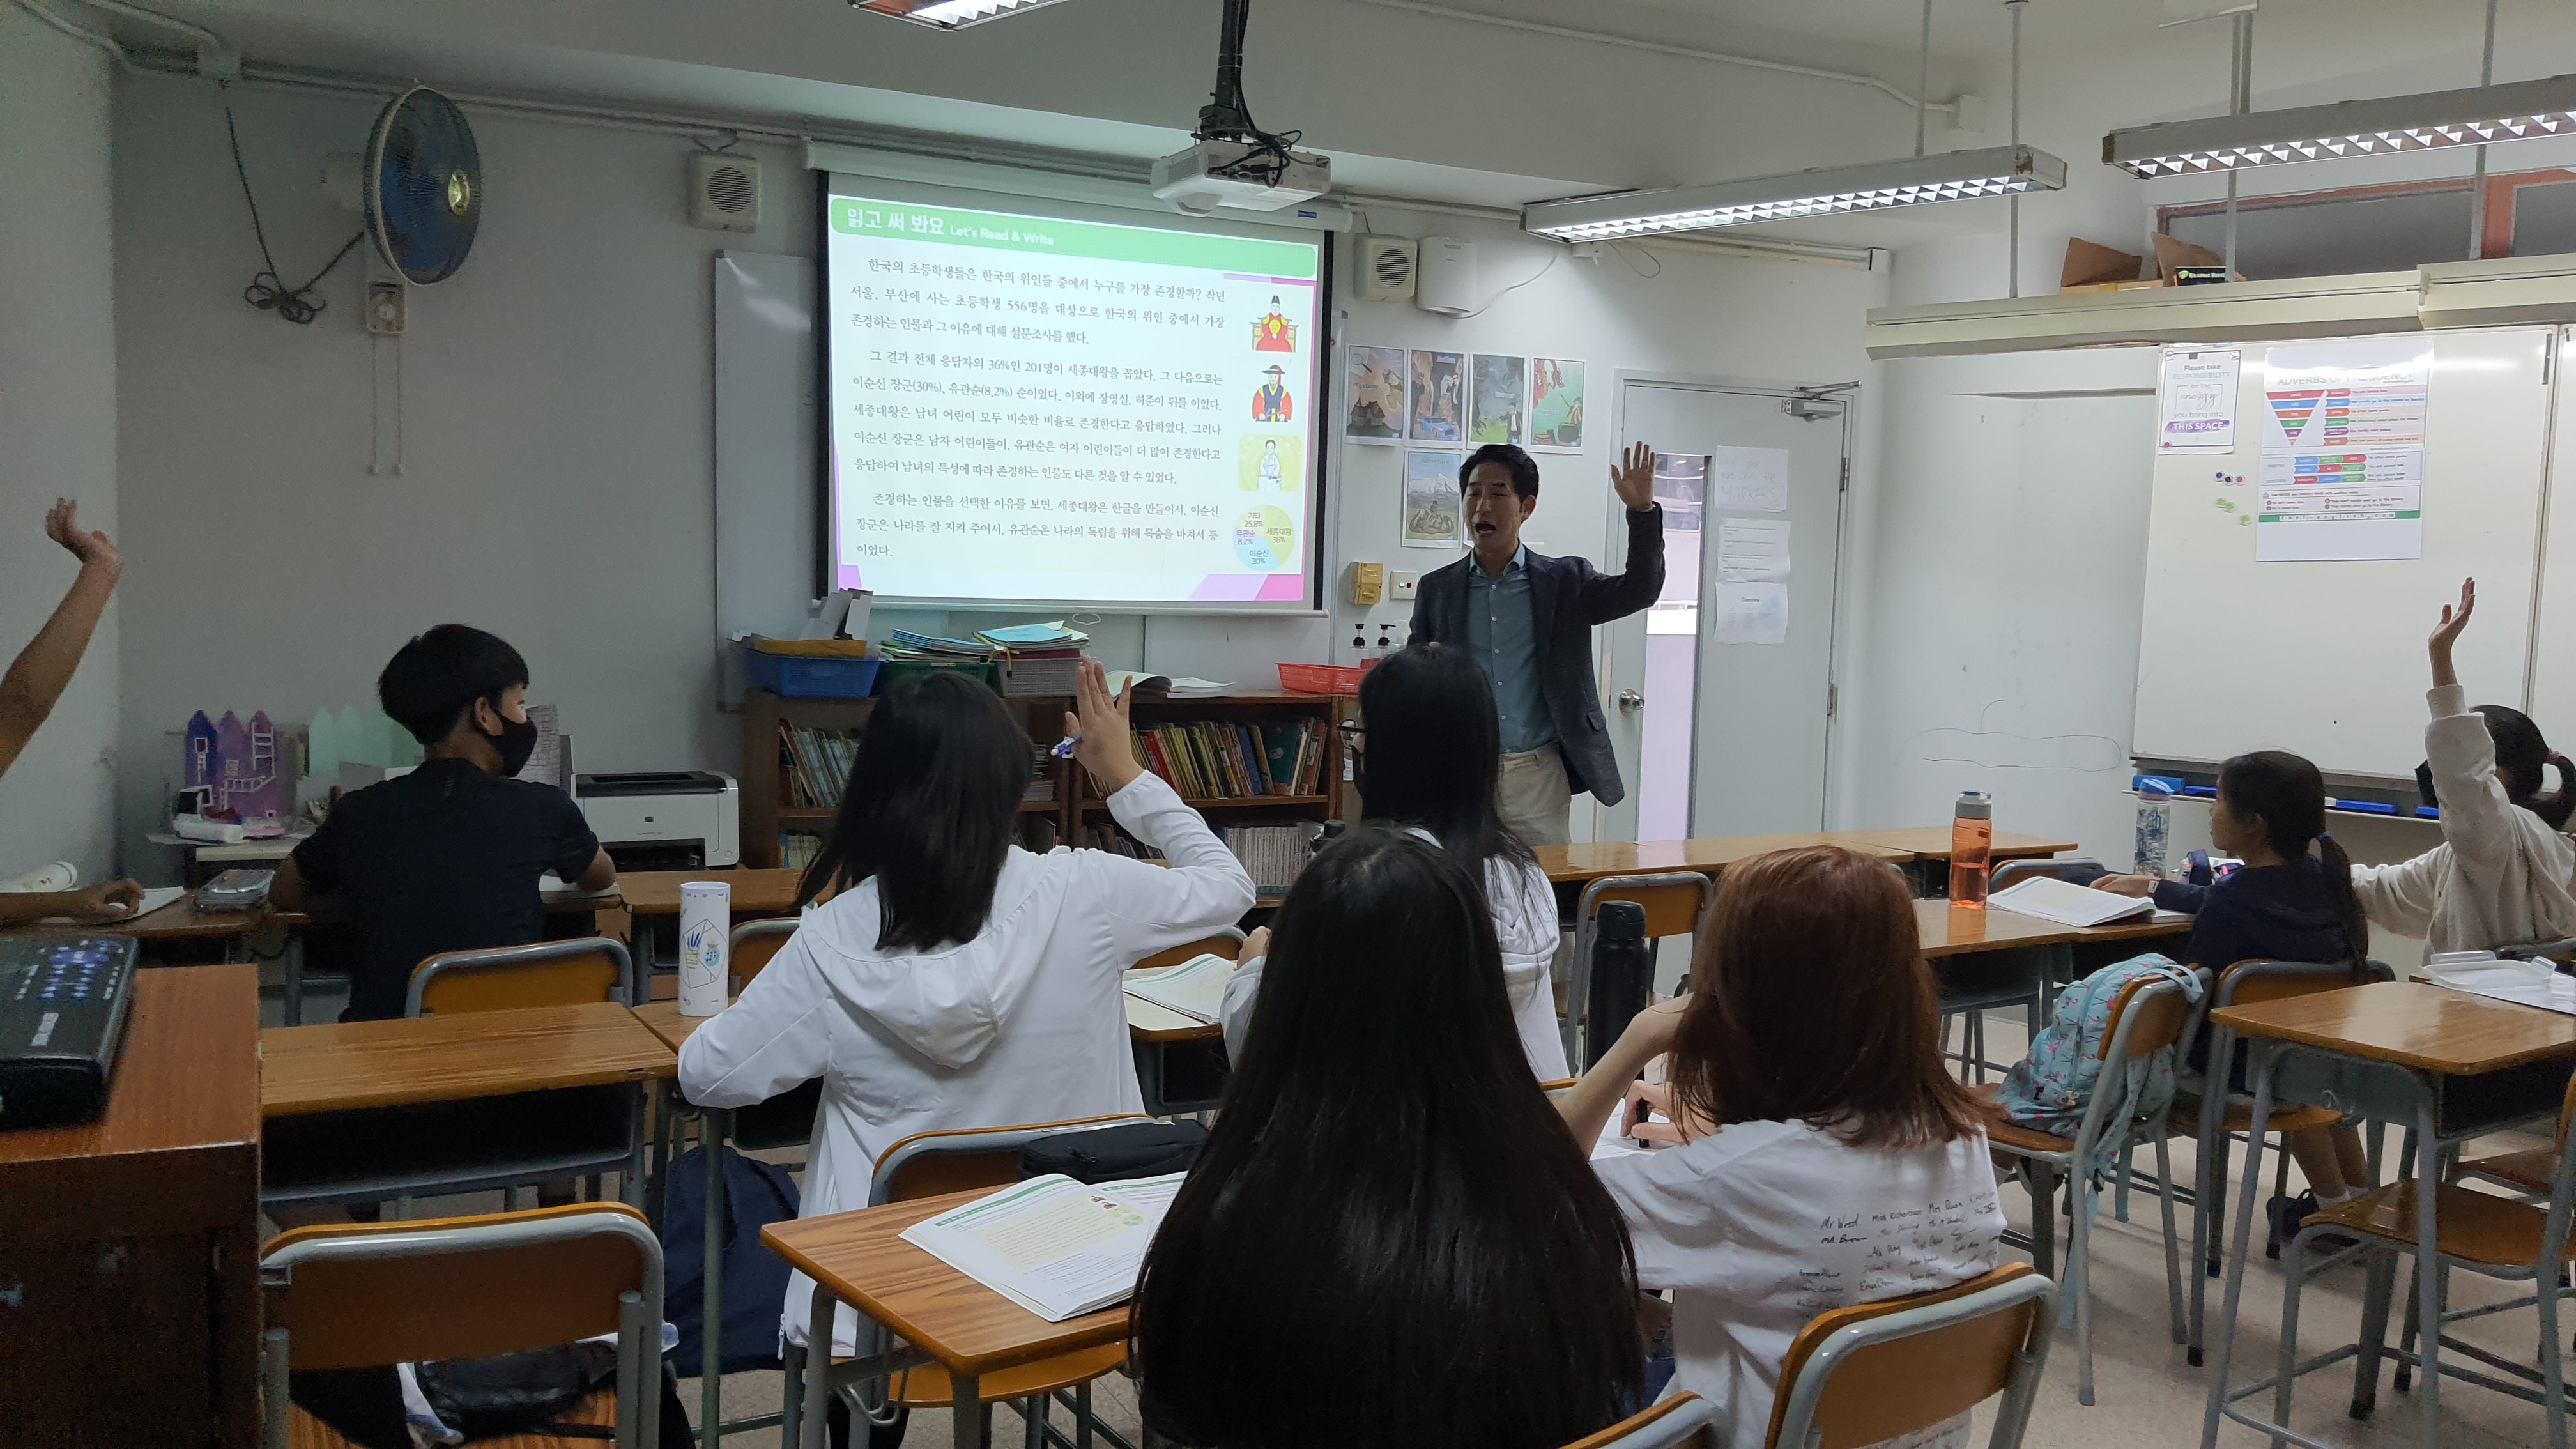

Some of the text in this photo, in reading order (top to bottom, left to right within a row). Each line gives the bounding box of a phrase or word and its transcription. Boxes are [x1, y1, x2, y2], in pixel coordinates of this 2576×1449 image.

[847, 207, 945, 236] 읽고 써 봐요
[949, 226, 1054, 246] Let's Read & Write
[867, 257, 1225, 303] 한국의 초등학생들은 한국의 위인들 중에서 누구를 가장 존경할까? 작년
[884, 288, 921, 303] 부산에
[926, 291, 950, 307] 사는
[954, 294, 1001, 310] 초등학생
[1006, 299, 1050, 315] 556명을
[1055, 302, 1100, 318] 대상으로
[1104, 306, 1137, 322] 한국의
[1142, 309, 1163, 324] 위인
[1167, 312, 1199, 326] 중에서
[1204, 314, 1225, 329] 가장
[850, 313, 1089, 345] 존경하는 인물과 그 이유에 대해 설문조사를 했다.
[869, 350, 882, 361] 그
[886, 349, 910, 364] 결과
[914, 351, 936, 366] 전체
[939, 353, 984, 370] 응답자의
[987, 358, 1021, 372] 36%인
[1024, 361, 1063, 375] 201명이
[1068, 363, 1119, 379] 세종대왕을
[1159, 371, 1170, 381] 그
[1174, 370, 1223, 386] 다음으로는
[2172, 371, 2230, 379] RESPONSIBILITY
[852, 374, 887, 391] 이순신
[947, 381, 1013, 398] 유관순(8.2%)
[1016, 386, 1061, 402] 순이었다.
[1064, 389, 1095, 404] 이외에
[1135, 393, 1164, 408] 허준이
[1190, 397, 1222, 411] 이었다.
[853, 402, 1222, 436] 세종대왕은 남녀 어린이 모두 비슷한 비율로 존경한다고 응답하였다. 그러나
[2172, 422, 2223, 431] THIS SPACE
[853, 429, 887, 445] 이순신
[891, 431, 925, 447] 장군은
[927, 433, 951, 447] 남자
[1013, 438, 1056, 453] 유관순은
[1058, 440, 1080, 454] 여자
[1082, 442, 1133, 457] 어린이들이
[1136, 444, 1146, 457] 더
[1149, 445, 1169, 458] 많이
[1172, 447, 1221, 461] 존경한다고
[853, 457, 1177, 484] 응답하여 남녀의 특성에 따라 존경하는 인물도 다른 것을 알 수 있었다.
[871, 492, 918, 507] 존경하는
[921, 494, 955, 508] 인물을
[958, 494, 991, 510] 선택한
[993, 496, 1027, 510] 이유를
[1057, 499, 1108, 514] 세종대왕은
[1110, 501, 1142, 514] 한글을
[1190, 503, 1218, 518] 이순신
[855, 517, 890, 532] 장군은
[893, 518, 926, 533] 나라를
[928, 520, 942, 533] 잘
[1007, 523, 1050, 537] 유관순은
[1053, 524, 1084, 537] 나라의
[1086, 526, 1118, 539] 독립을
[1120, 526, 1140, 539] 위해
[1143, 526, 1174, 540] 목숨을
[1208, 529, 1218, 542] 등
[856, 543, 893, 557] 이었다.
